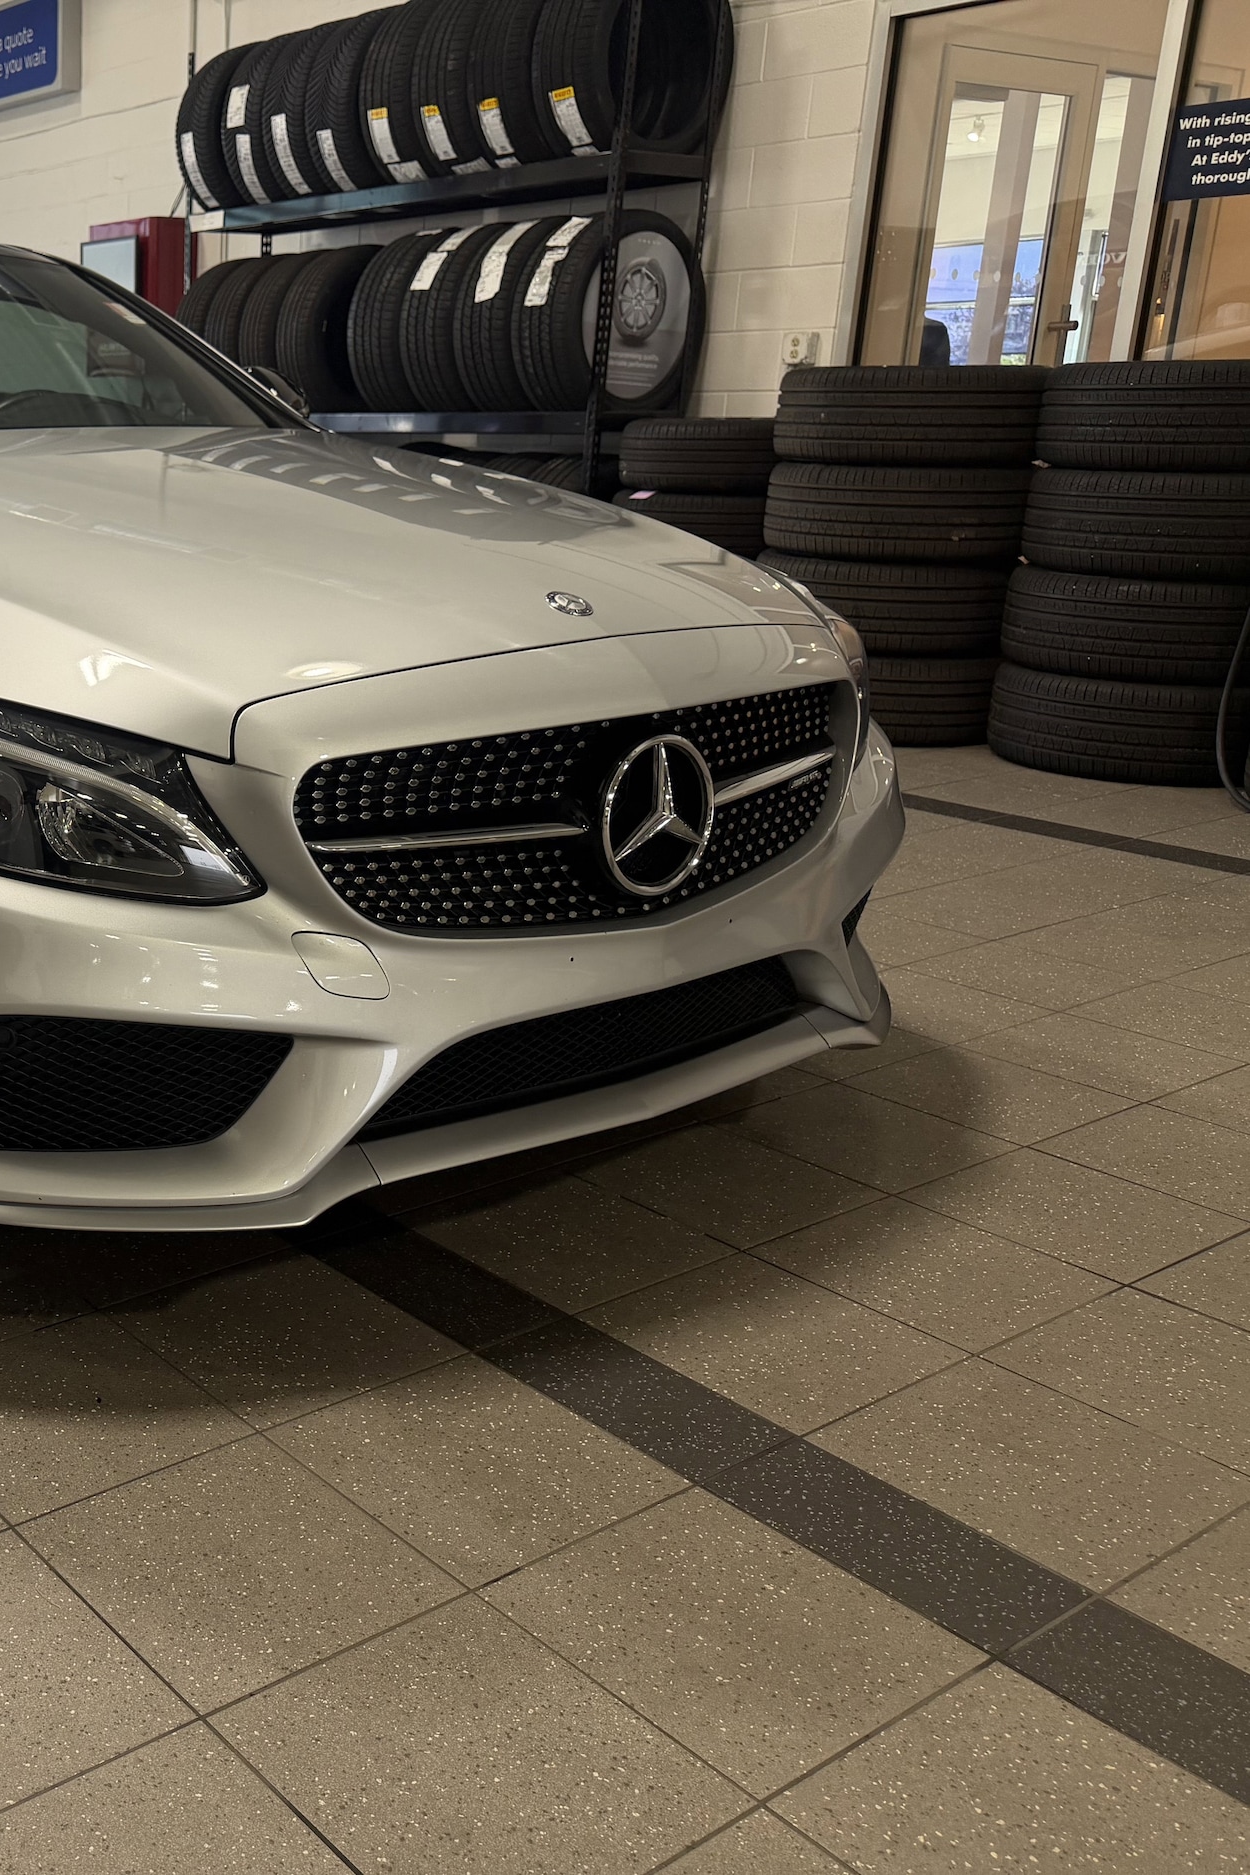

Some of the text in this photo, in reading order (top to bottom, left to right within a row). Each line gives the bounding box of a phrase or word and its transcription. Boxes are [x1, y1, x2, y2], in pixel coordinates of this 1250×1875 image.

[4, 27, 34, 54] quote
[3, 59, 23, 80] you
[24, 46, 47, 69] wait
[1179, 115, 1211, 130] With
[1187, 132, 1250, 148] in tip-top
[1191, 154, 1208, 166] At
